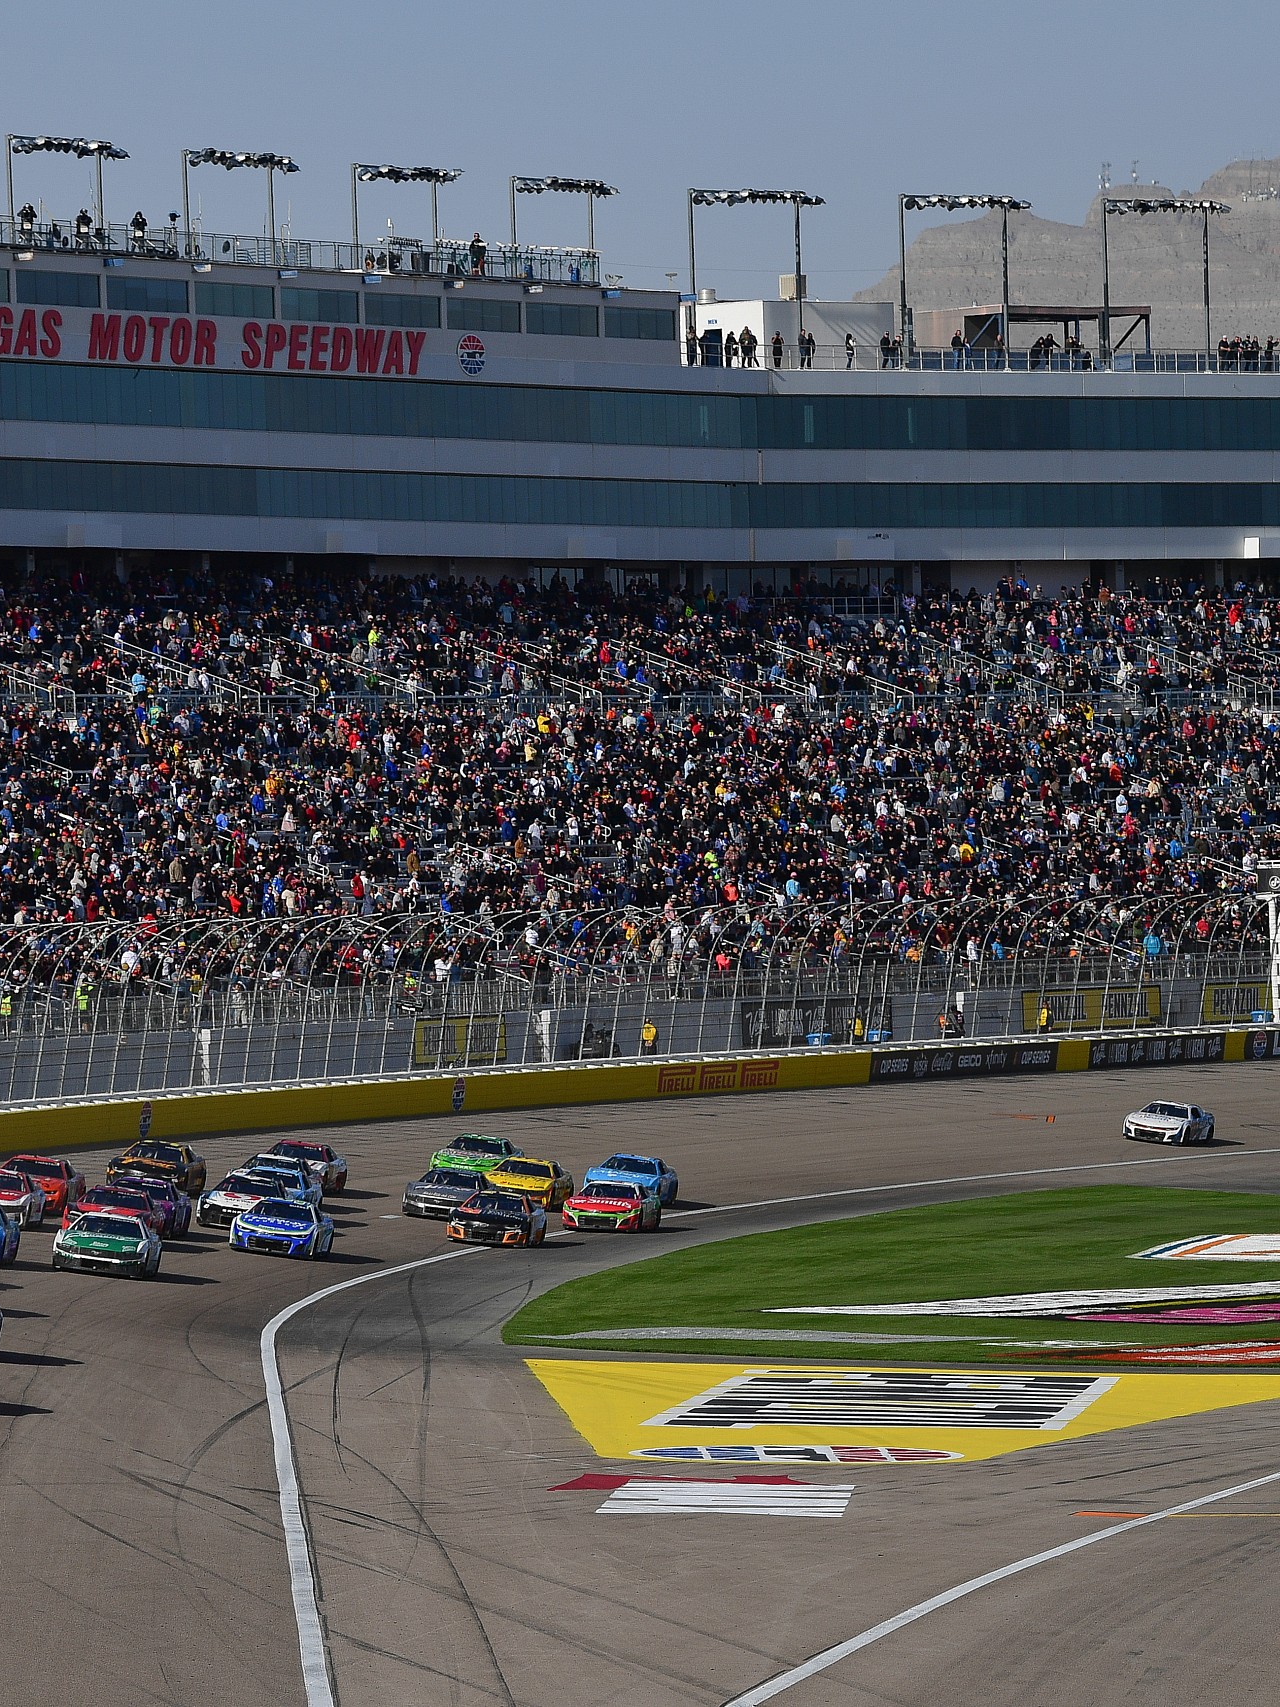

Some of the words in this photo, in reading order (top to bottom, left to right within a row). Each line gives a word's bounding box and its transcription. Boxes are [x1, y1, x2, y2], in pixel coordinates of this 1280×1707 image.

[87, 313, 217, 366] MOTOR
[241, 321, 426, 376] SPEEDWAY
[658, 1065, 697, 1093] PIRELLI
[700, 1063, 737, 1090] PIRELLI
[741, 1060, 780, 1088] PIRELLI
[958, 1055, 982, 1068] GEICO
